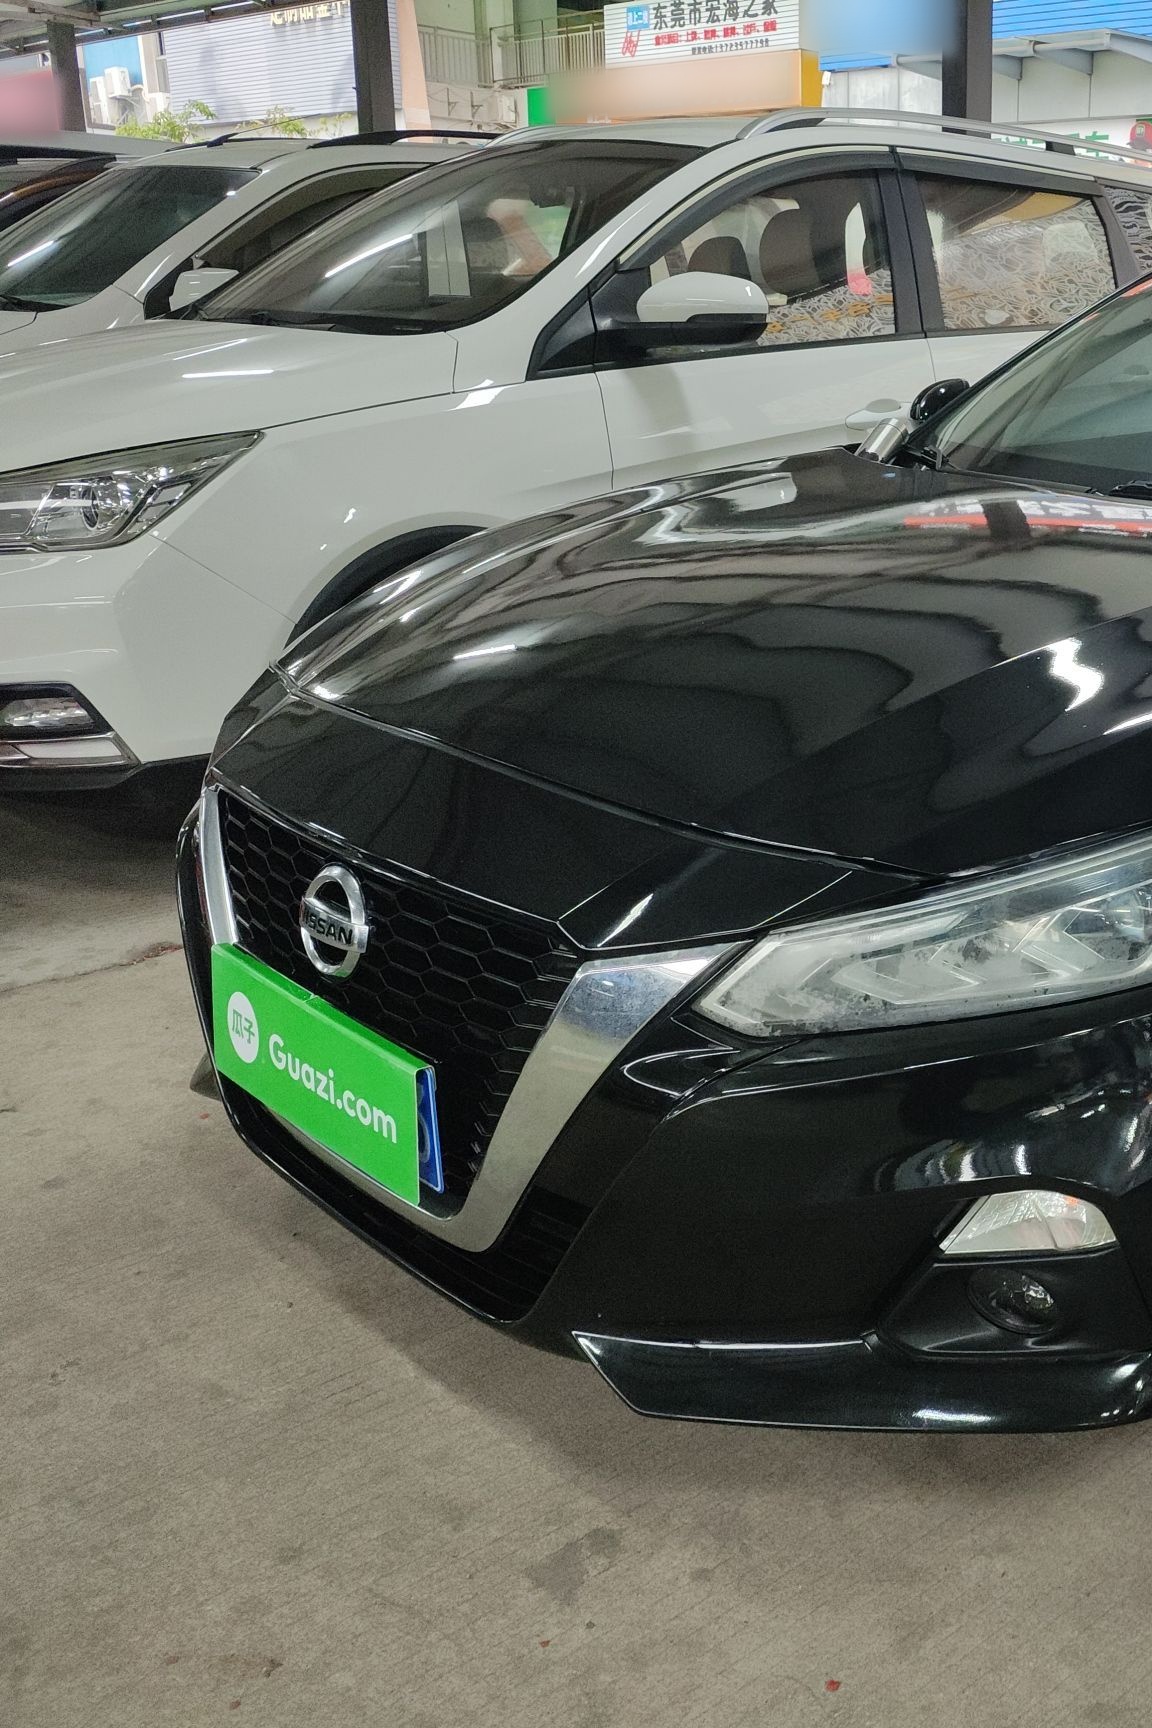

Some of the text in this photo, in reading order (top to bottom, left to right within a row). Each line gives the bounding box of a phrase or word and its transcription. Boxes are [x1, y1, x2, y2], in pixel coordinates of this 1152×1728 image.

[653, 0, 778, 30] 东莞市宏海之家
[232, 1008, 255, 1044] 瓜子
[268, 1033, 397, 1144] Guazi.com
